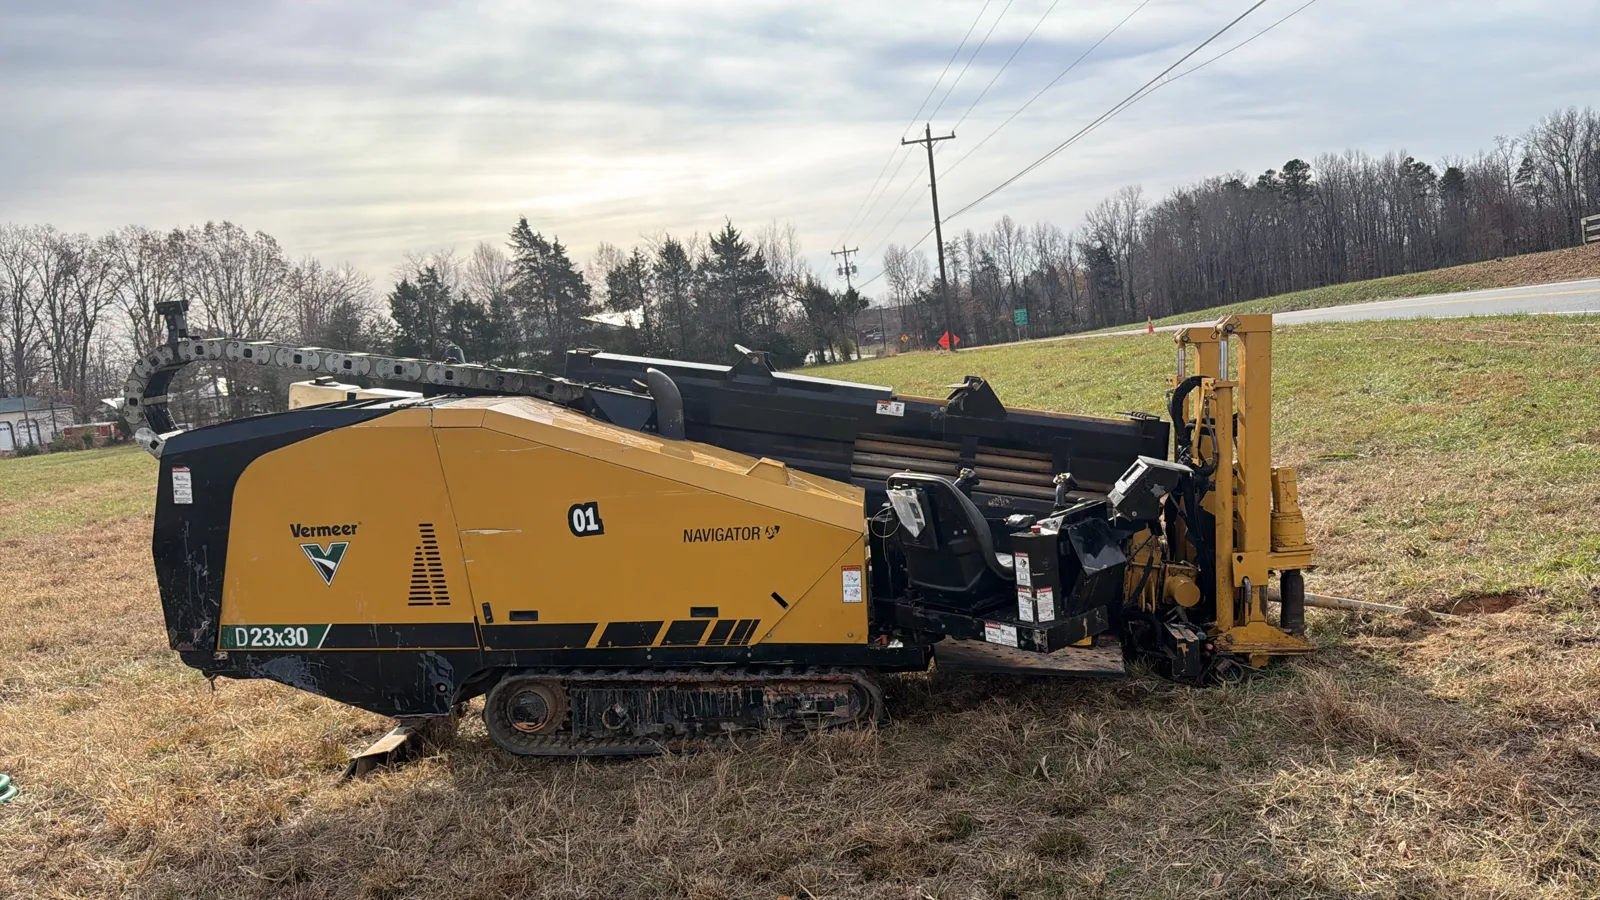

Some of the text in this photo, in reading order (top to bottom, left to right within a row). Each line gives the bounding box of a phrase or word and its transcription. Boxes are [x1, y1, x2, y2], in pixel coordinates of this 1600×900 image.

[573, 507, 599, 533] 01
[290, 523, 358, 538] Vermeer
[683, 526, 761, 543] NAVIGATOR
[235, 627, 309, 647] D23x30
